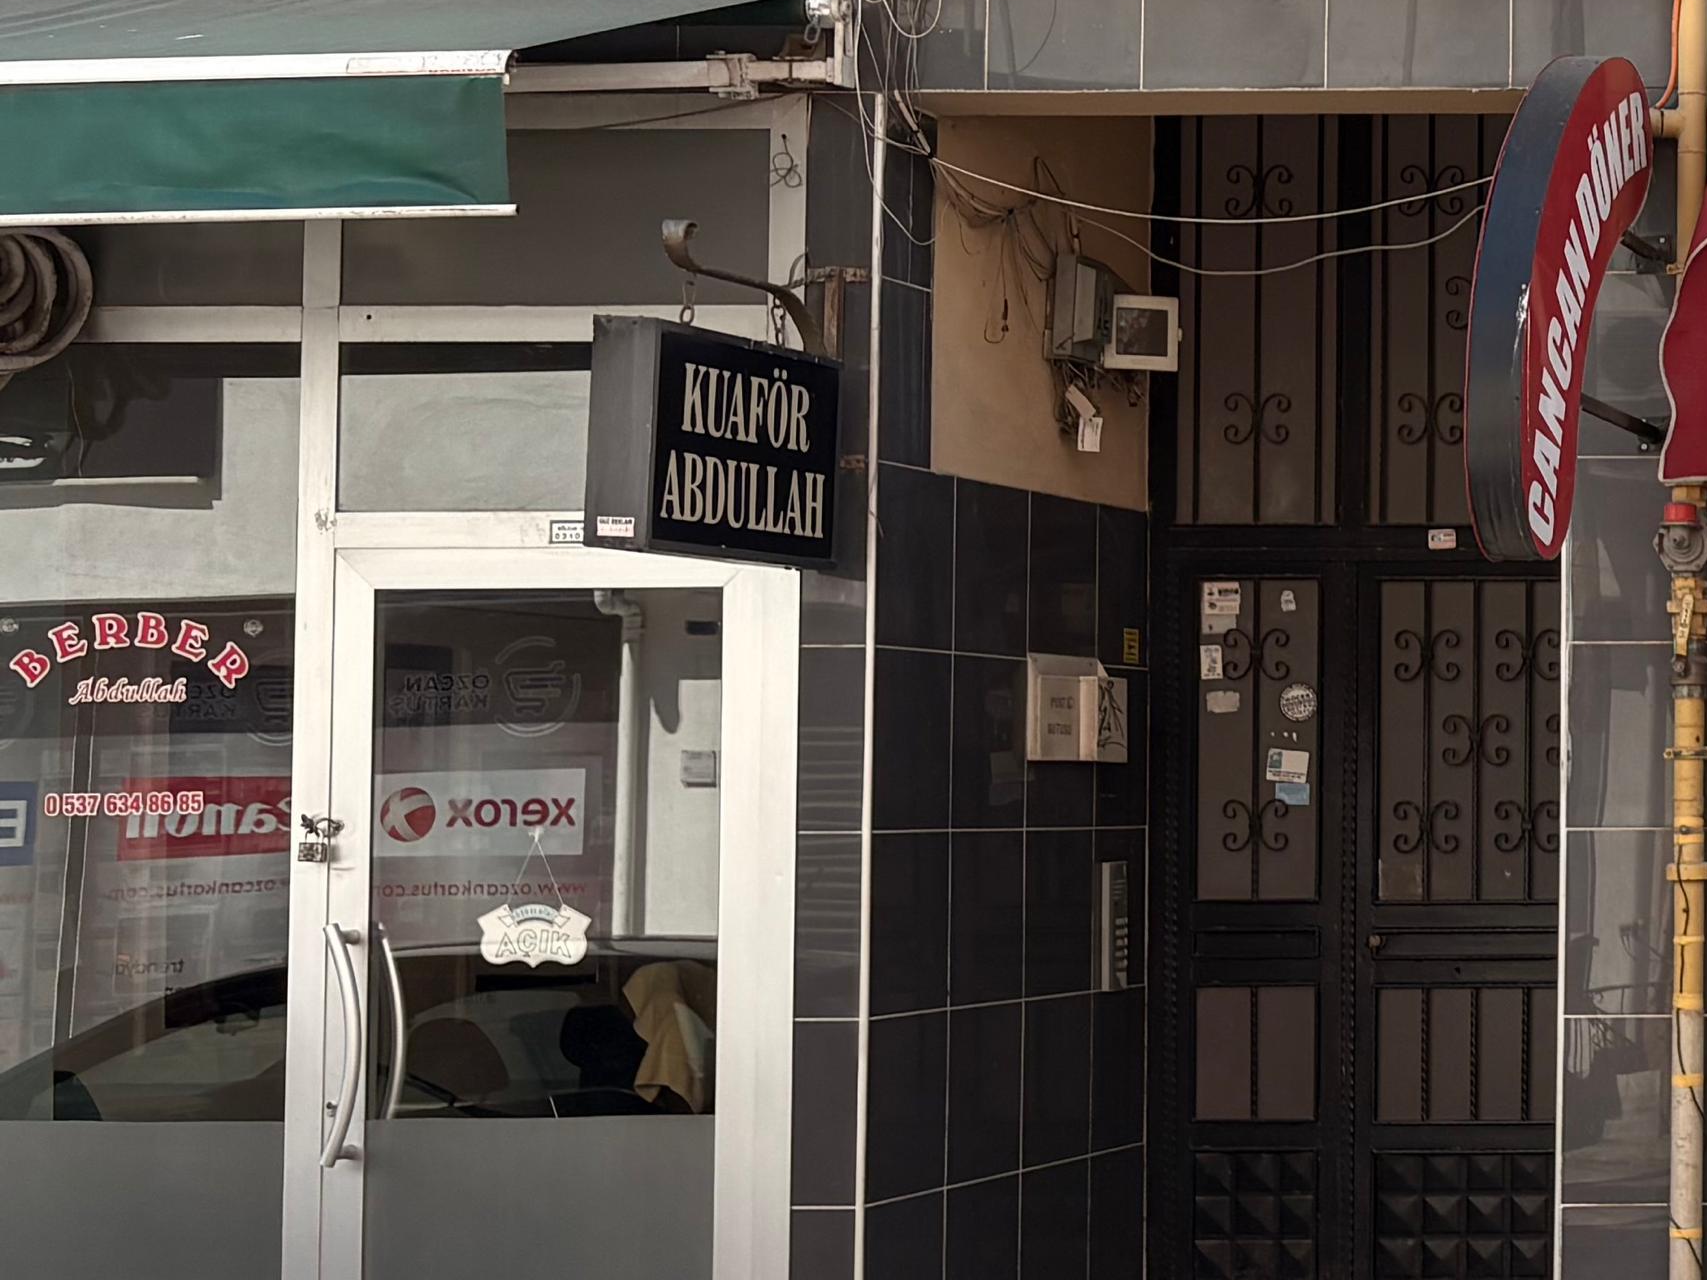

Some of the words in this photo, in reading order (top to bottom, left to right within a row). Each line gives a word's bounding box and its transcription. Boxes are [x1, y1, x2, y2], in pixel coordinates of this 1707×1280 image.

[681, 362, 811, 454] KUAFÖR
[659, 449, 826, 539] ABDULLAH
[10, 611, 250, 689] BERBER
[68, 676, 188, 705] Abdullah
[44, 794, 59, 817] 0
[62, 794, 100, 817] 537
[104, 794, 143, 816] 634
[146, 793, 174, 816] 86
[176, 791, 203, 816] 85
[496, 929, 571, 958] AÇIK
